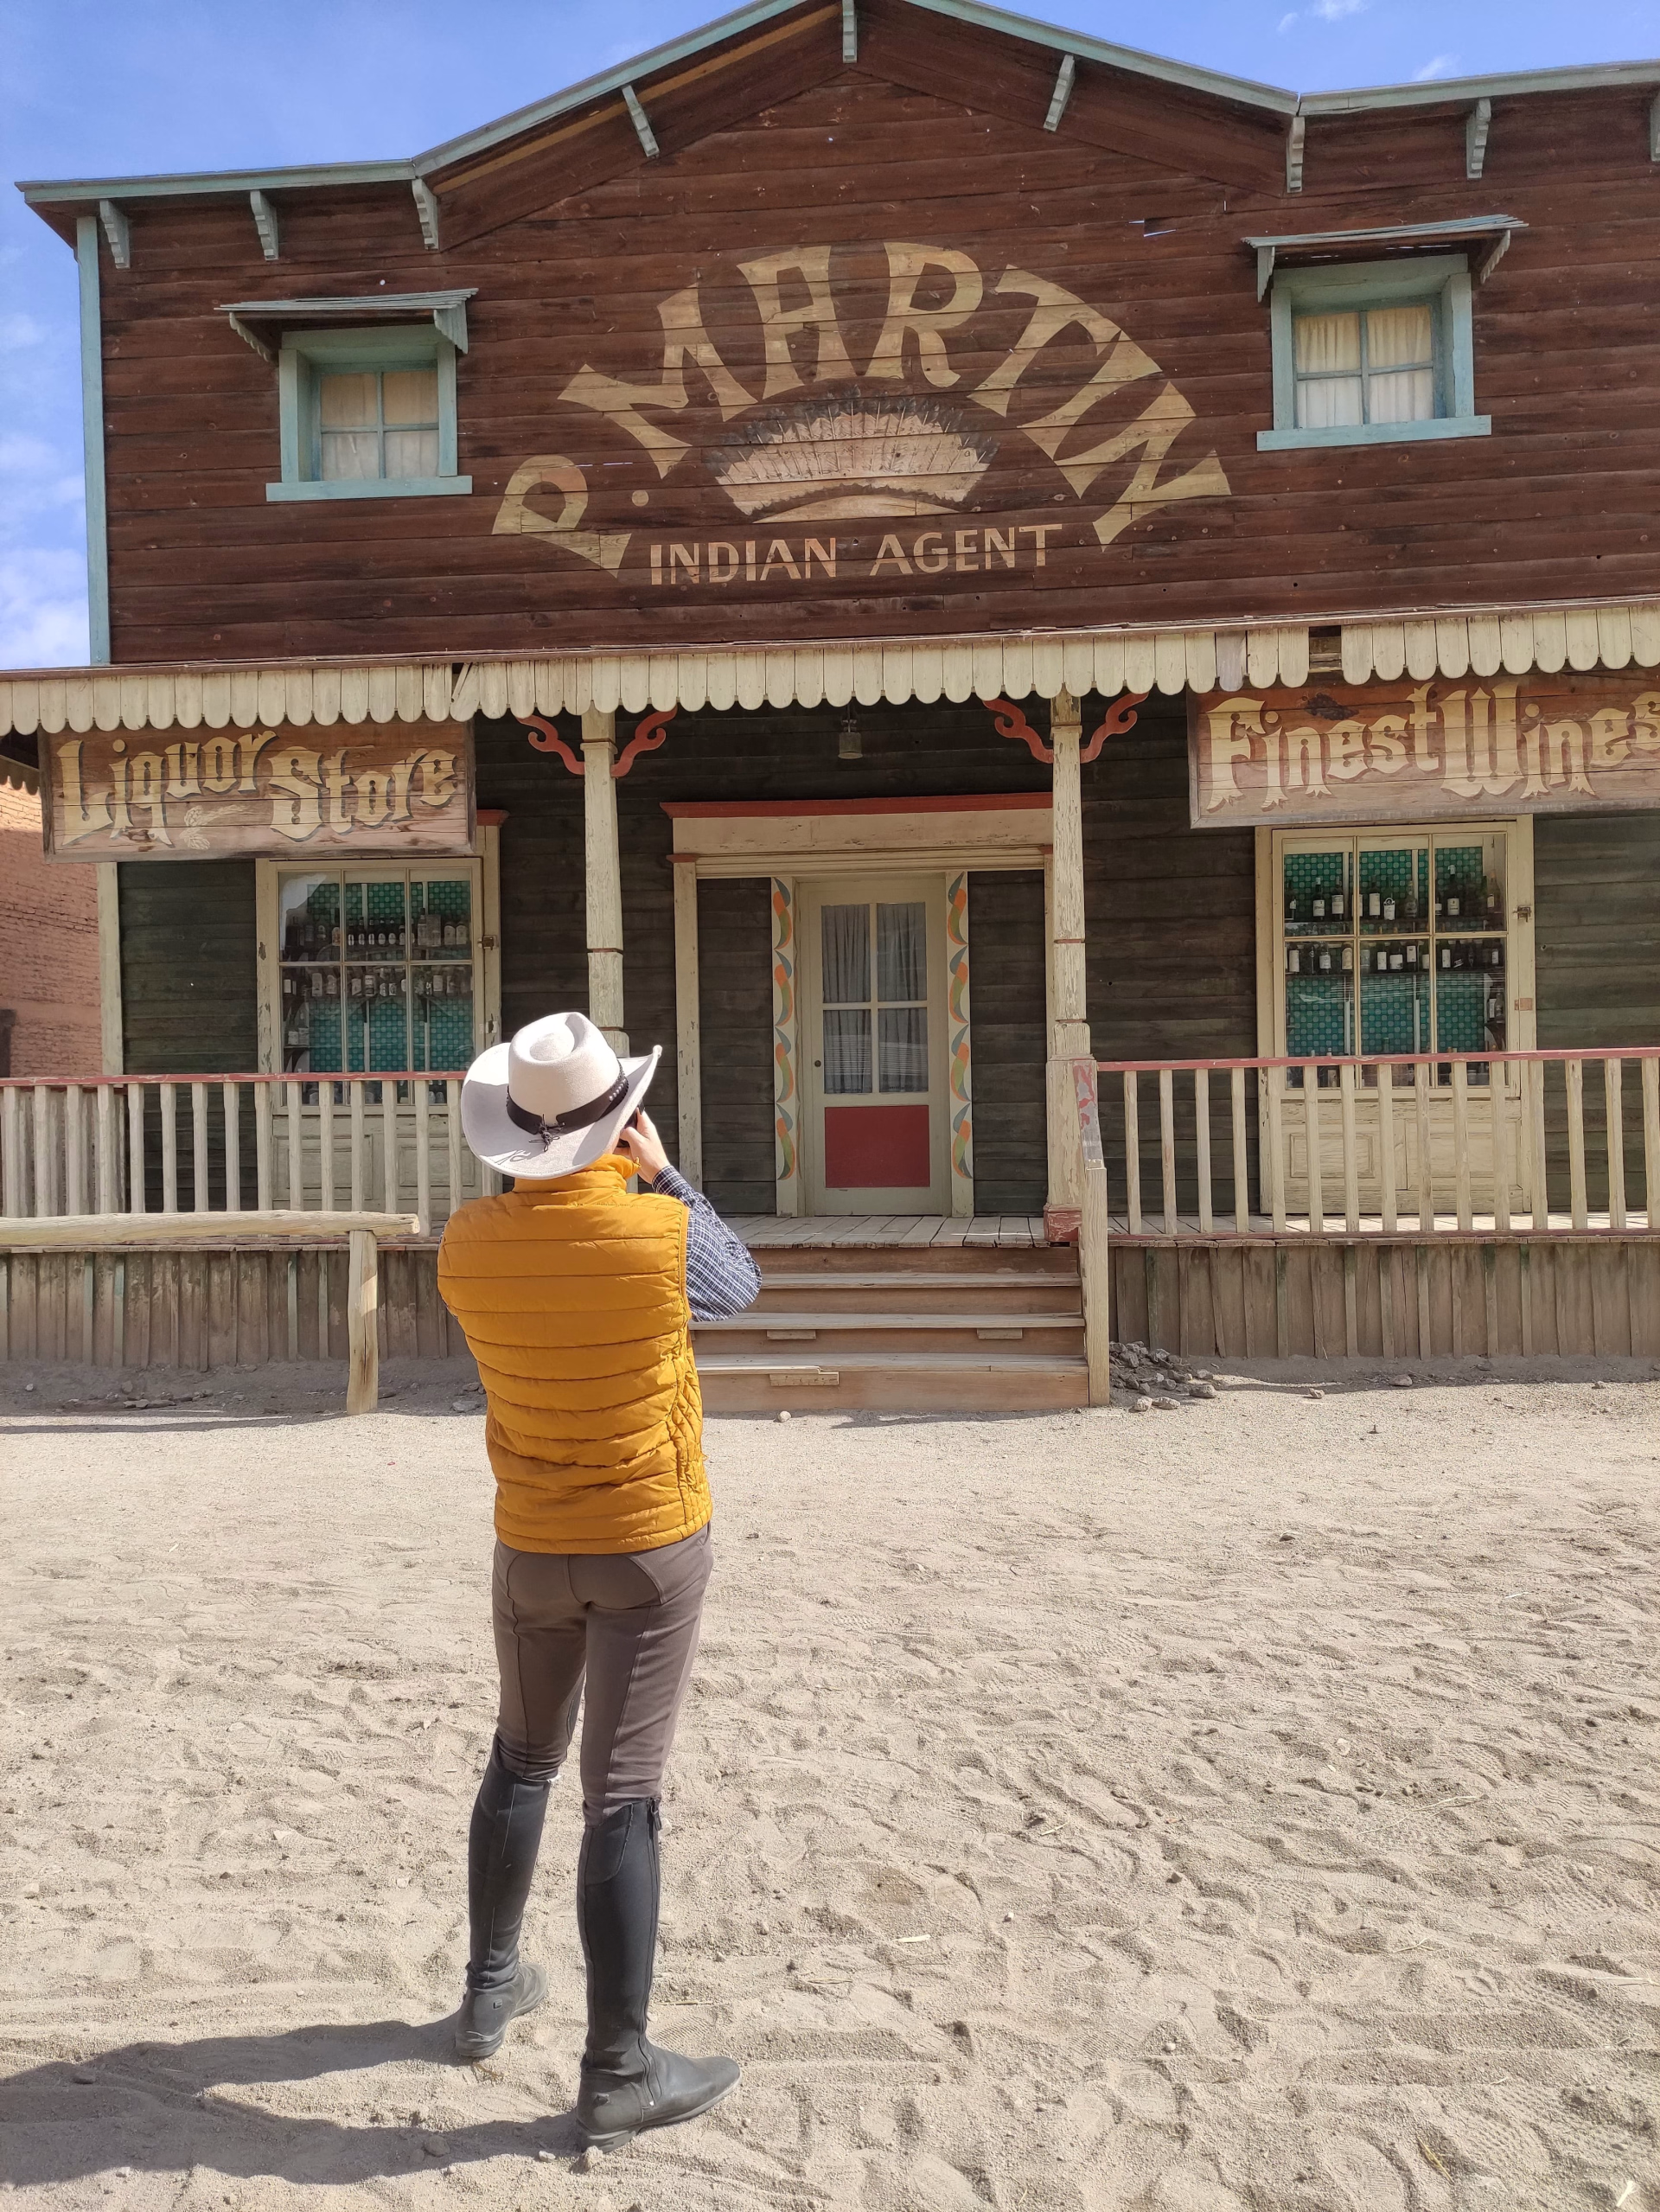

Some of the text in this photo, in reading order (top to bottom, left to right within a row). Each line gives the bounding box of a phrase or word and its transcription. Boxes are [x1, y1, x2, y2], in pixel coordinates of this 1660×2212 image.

[558, 242, 1231, 552] MARTIN
[650, 523, 1063, 586] INDIAN AGENT
[57, 730, 460, 848] Liquor Store
[1205, 682, 1440, 812] Finest
